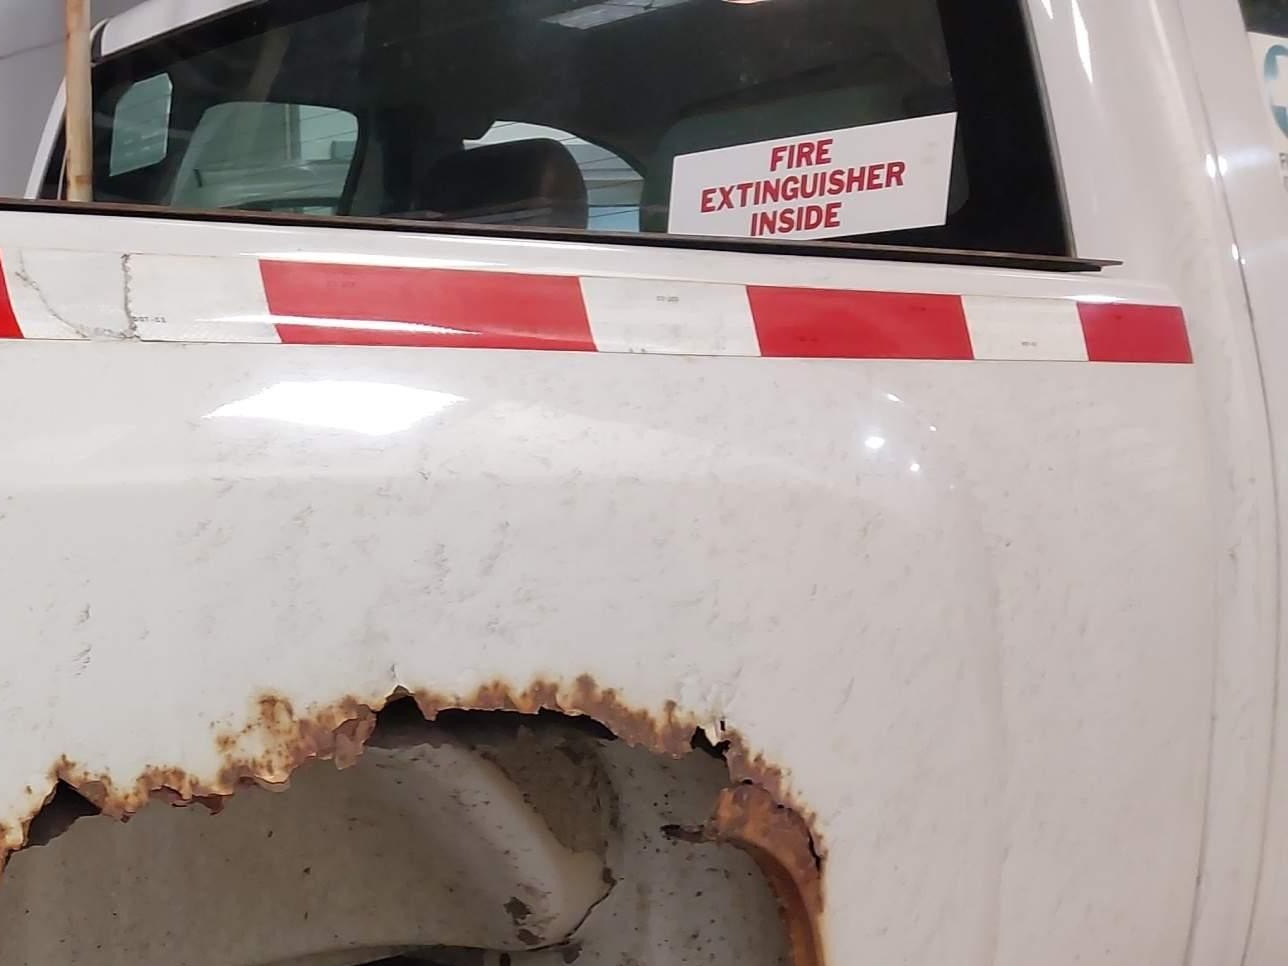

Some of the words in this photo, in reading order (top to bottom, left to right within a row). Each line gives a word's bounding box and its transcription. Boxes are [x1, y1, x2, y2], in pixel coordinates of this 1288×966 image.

[770, 139, 834, 172] FIRE
[701, 161, 906, 213] EXTINGUISHER
[750, 202, 843, 237] INSIDE
